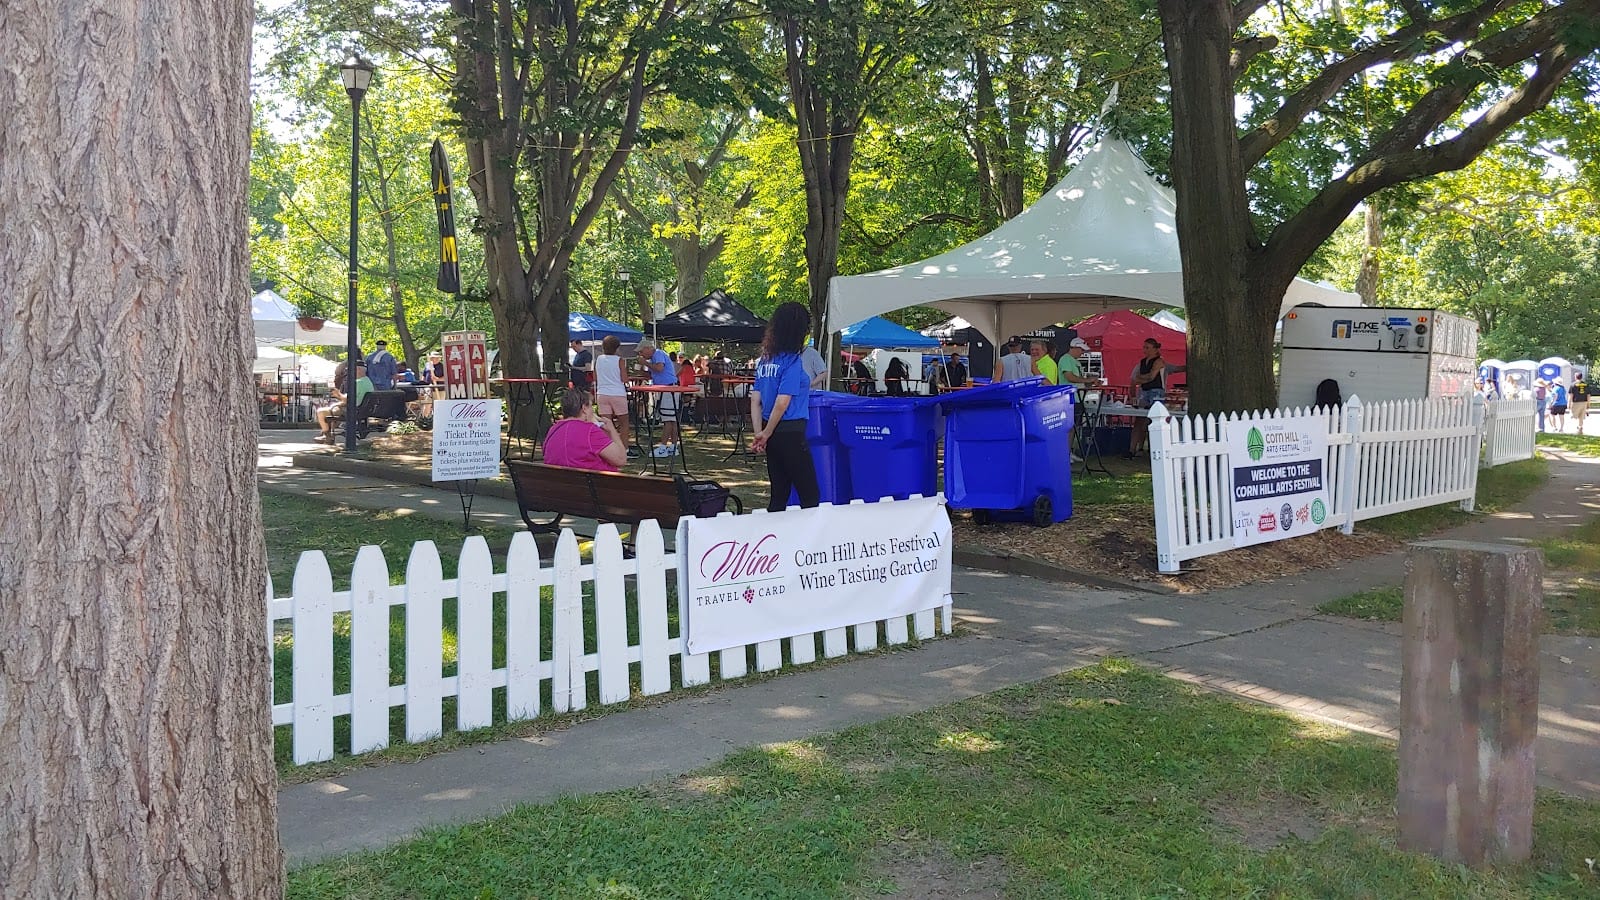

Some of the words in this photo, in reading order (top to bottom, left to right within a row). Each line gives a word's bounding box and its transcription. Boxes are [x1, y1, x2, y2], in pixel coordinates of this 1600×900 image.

[1353, 321, 1379, 330] LAKE
[449, 345, 466, 399] ATM
[472, 344, 487, 398] ATM
[451, 401, 487, 420] Wine
[444, 430, 468, 439] Ticket
[469, 429, 491, 438] Prices
[1285, 431, 1299, 442] HILL
[457, 457, 468, 465] plus
[1251, 467, 1287, 481] WELCOME
[1287, 466, 1296, 477] TO
[1297, 464, 1310, 475] THE
[1236, 483, 1258, 498] CORN
[1260, 482, 1275, 495] HILL
[1276, 481, 1293, 493] ARTS
[1294, 477, 1320, 490] FESTIVAL
[700, 533, 780, 583] Wine
[794, 550, 828, 568] Corn
[832, 542, 856, 562] Hill
[860, 541, 887, 558] Arts
[889, 531, 941, 555] Festival
[799, 571, 836, 591] Wine
[838, 564, 887, 585] Tasting
[890, 557, 939, 576] Garden
[696, 591, 740, 607] TRAVEL
[758, 584, 787, 598] CARD
